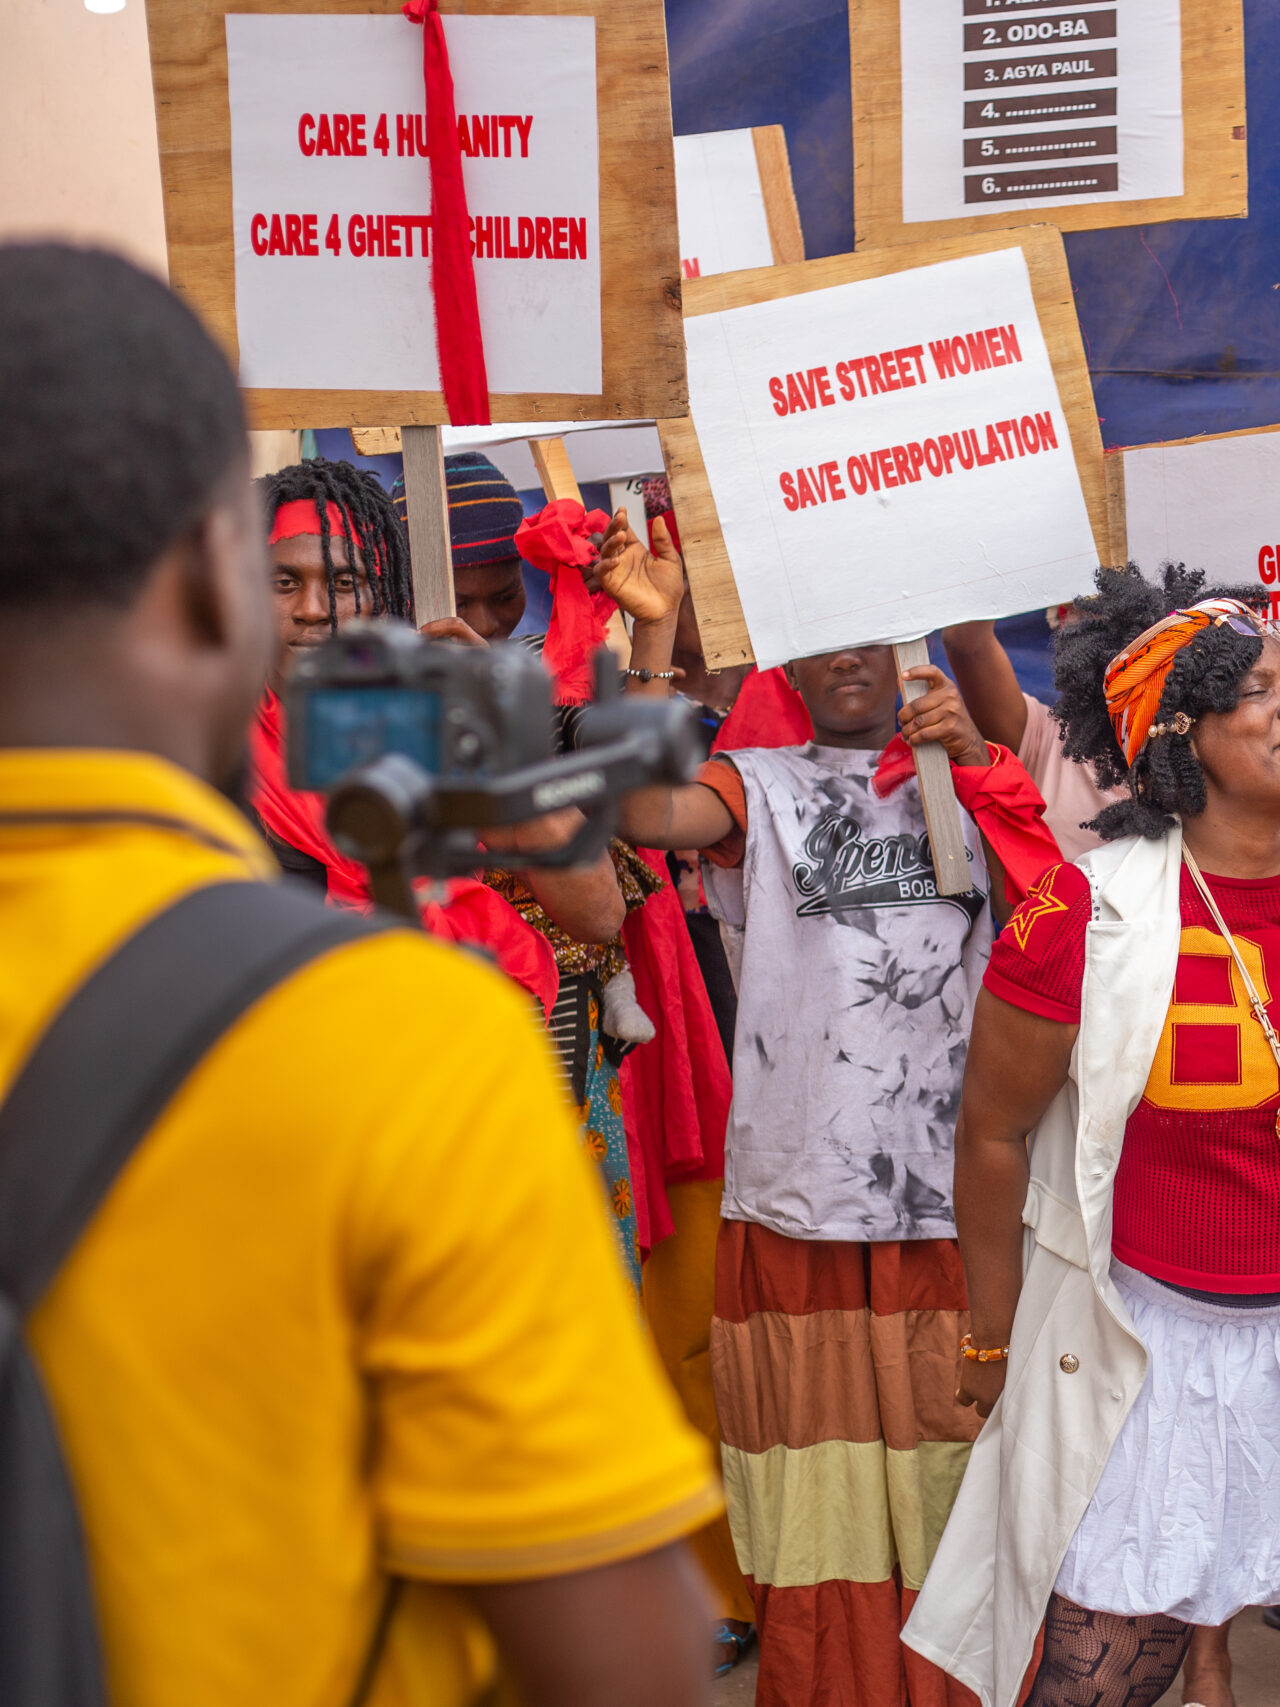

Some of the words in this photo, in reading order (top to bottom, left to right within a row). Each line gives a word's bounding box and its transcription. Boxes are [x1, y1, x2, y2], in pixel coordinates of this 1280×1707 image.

[982, 28, 1002, 45] 2.
[1007, 19, 1089, 42] ODO-BA
[984, 69, 1000, 82] 3.
[1003, 64, 1049, 80] AGYA
[1052, 59, 1095, 76] PAUL
[980, 102, 1000, 119] 4.
[298, 113, 367, 157] CARE
[373, 113, 391, 157] 4
[396, 113, 533, 158] HUANITY
[981, 139, 1000, 156] 5.
[981, 177, 1001, 194] 6.
[251, 213, 319, 257] CARE
[324, 213, 342, 257] 4
[348, 214, 433, 258] GHETT
[769, 366, 836, 417] SAVE
[836, 344, 927, 401] STREET
[928, 323, 1023, 380] WOMEN
[780, 461, 846, 512] SAVE
[847, 411, 1059, 496] OVERPOPULATION
